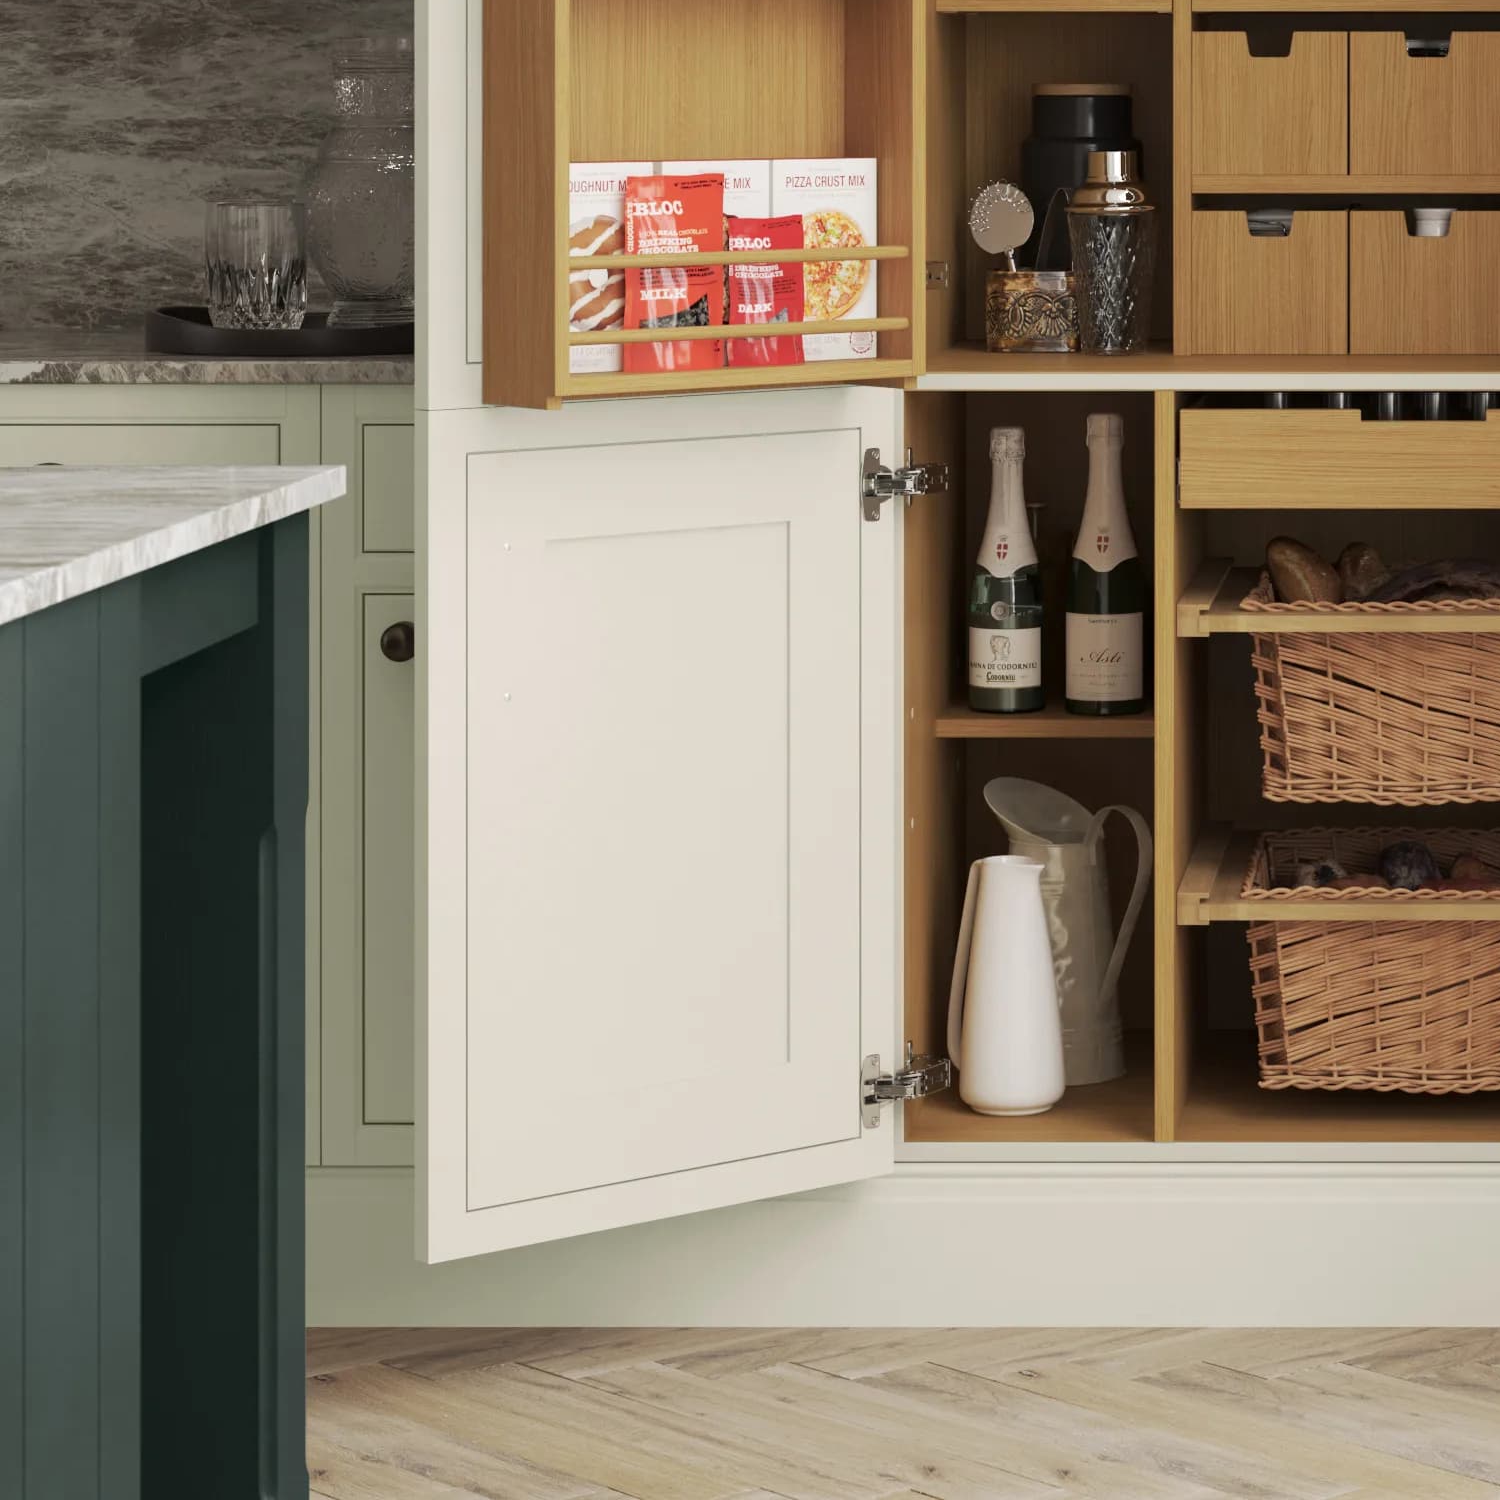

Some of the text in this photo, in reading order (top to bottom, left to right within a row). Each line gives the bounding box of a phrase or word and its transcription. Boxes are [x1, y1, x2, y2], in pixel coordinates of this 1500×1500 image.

[733, 177, 752, 189] MIX
[785, 175, 866, 188] PIZZA CRUST MIX
[634, 201, 684, 216] BLOC
[733, 237, 772, 249] BLOC
[640, 288, 687, 300] MILK
[738, 303, 773, 314] DARK
[1079, 647, 1126, 663] Asti
